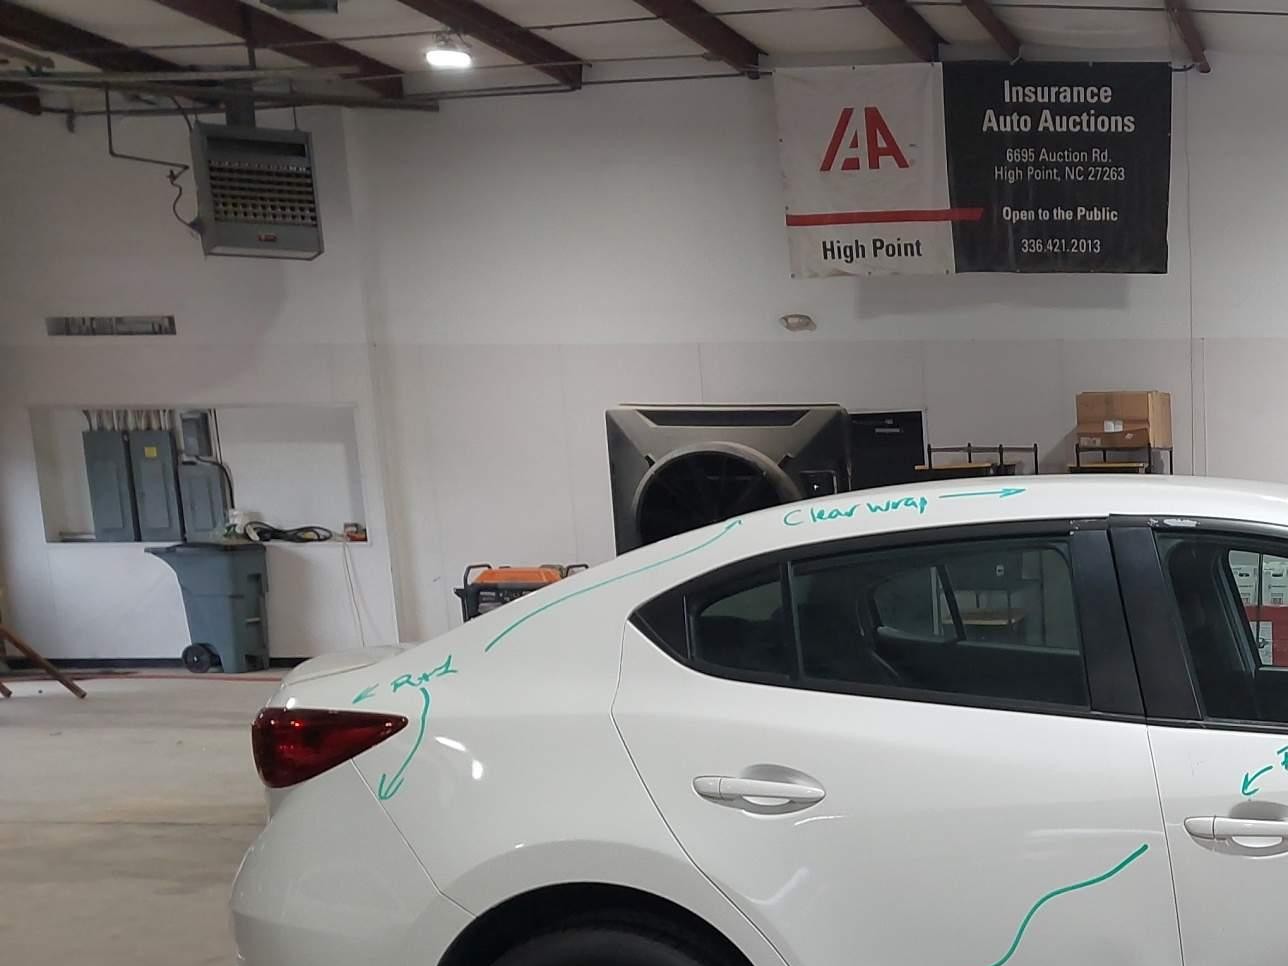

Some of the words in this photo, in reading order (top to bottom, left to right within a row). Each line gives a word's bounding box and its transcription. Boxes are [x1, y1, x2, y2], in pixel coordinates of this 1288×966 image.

[1003, 79, 1112, 103] Insurance
[982, 108, 1032, 132] Auto
[1038, 108, 1136, 132] Auctions
[1006, 147, 1035, 162] 6695
[1039, 147, 1088, 162] Auction
[1092, 147, 1112, 162] Rd.
[994, 165, 1023, 184] High
[1027, 165, 1061, 182] Point,
[1065, 166, 1085, 181] NC
[1087, 166, 1126, 181] 27263
[1002, 206, 1035, 224] Open
[1038, 208, 1050, 221] to
[1053, 206, 1073, 221] the
[1077, 206, 1119, 221] Public
[822, 239, 866, 264] High
[872, 237, 923, 259] Point
[1021, 238, 1101, 254] 336.421.2013
